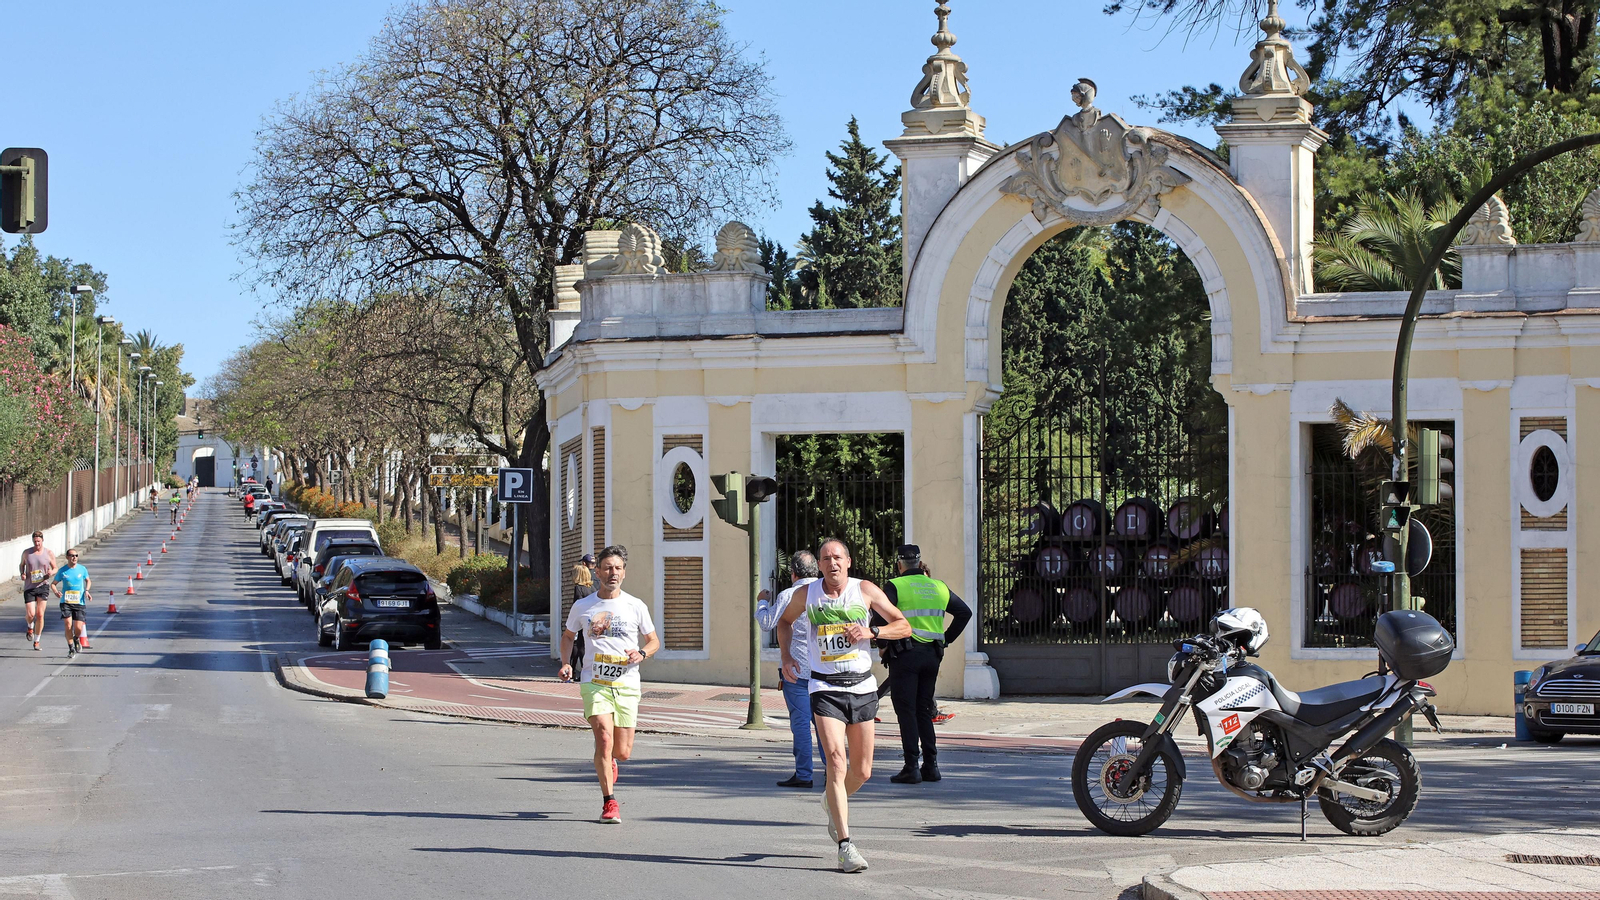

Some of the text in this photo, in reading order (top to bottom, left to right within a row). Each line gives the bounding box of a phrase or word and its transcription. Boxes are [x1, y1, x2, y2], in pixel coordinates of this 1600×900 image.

[504, 472, 524, 498] P
[824, 636, 852, 650] 1165
[598, 664, 622, 678] 1225
[1214, 682, 1252, 706] POLICIA LOCAL
[1556, 704, 1590, 714] 0100 FZN
[1224, 716, 1238, 728] 112
